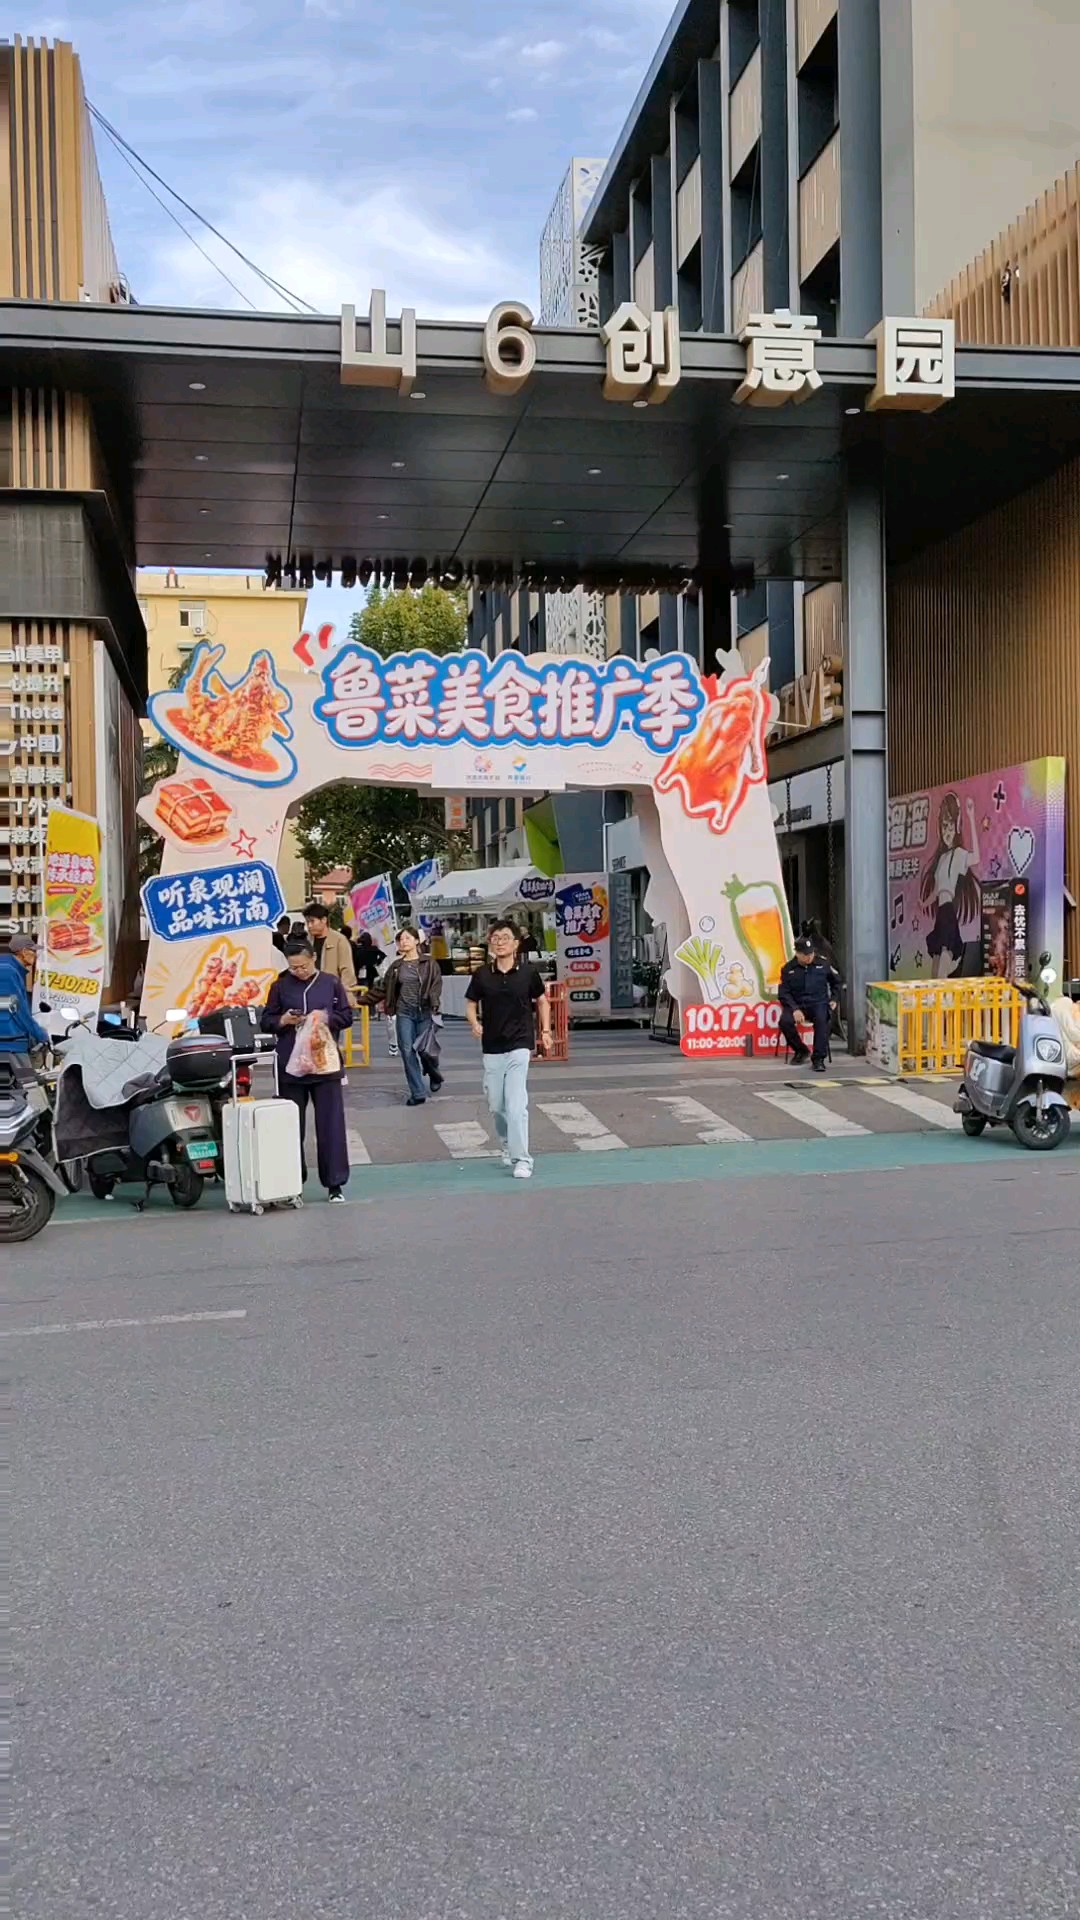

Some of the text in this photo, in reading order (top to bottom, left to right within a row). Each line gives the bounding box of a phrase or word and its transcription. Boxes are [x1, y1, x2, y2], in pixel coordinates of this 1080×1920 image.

[341, 289, 956, 408] 山6创意园
[321, 650, 699, 749] 鲁菜美食推广季
[158, 869, 266, 908] 听泉观澜
[168, 896, 269, 935] 品味济南
